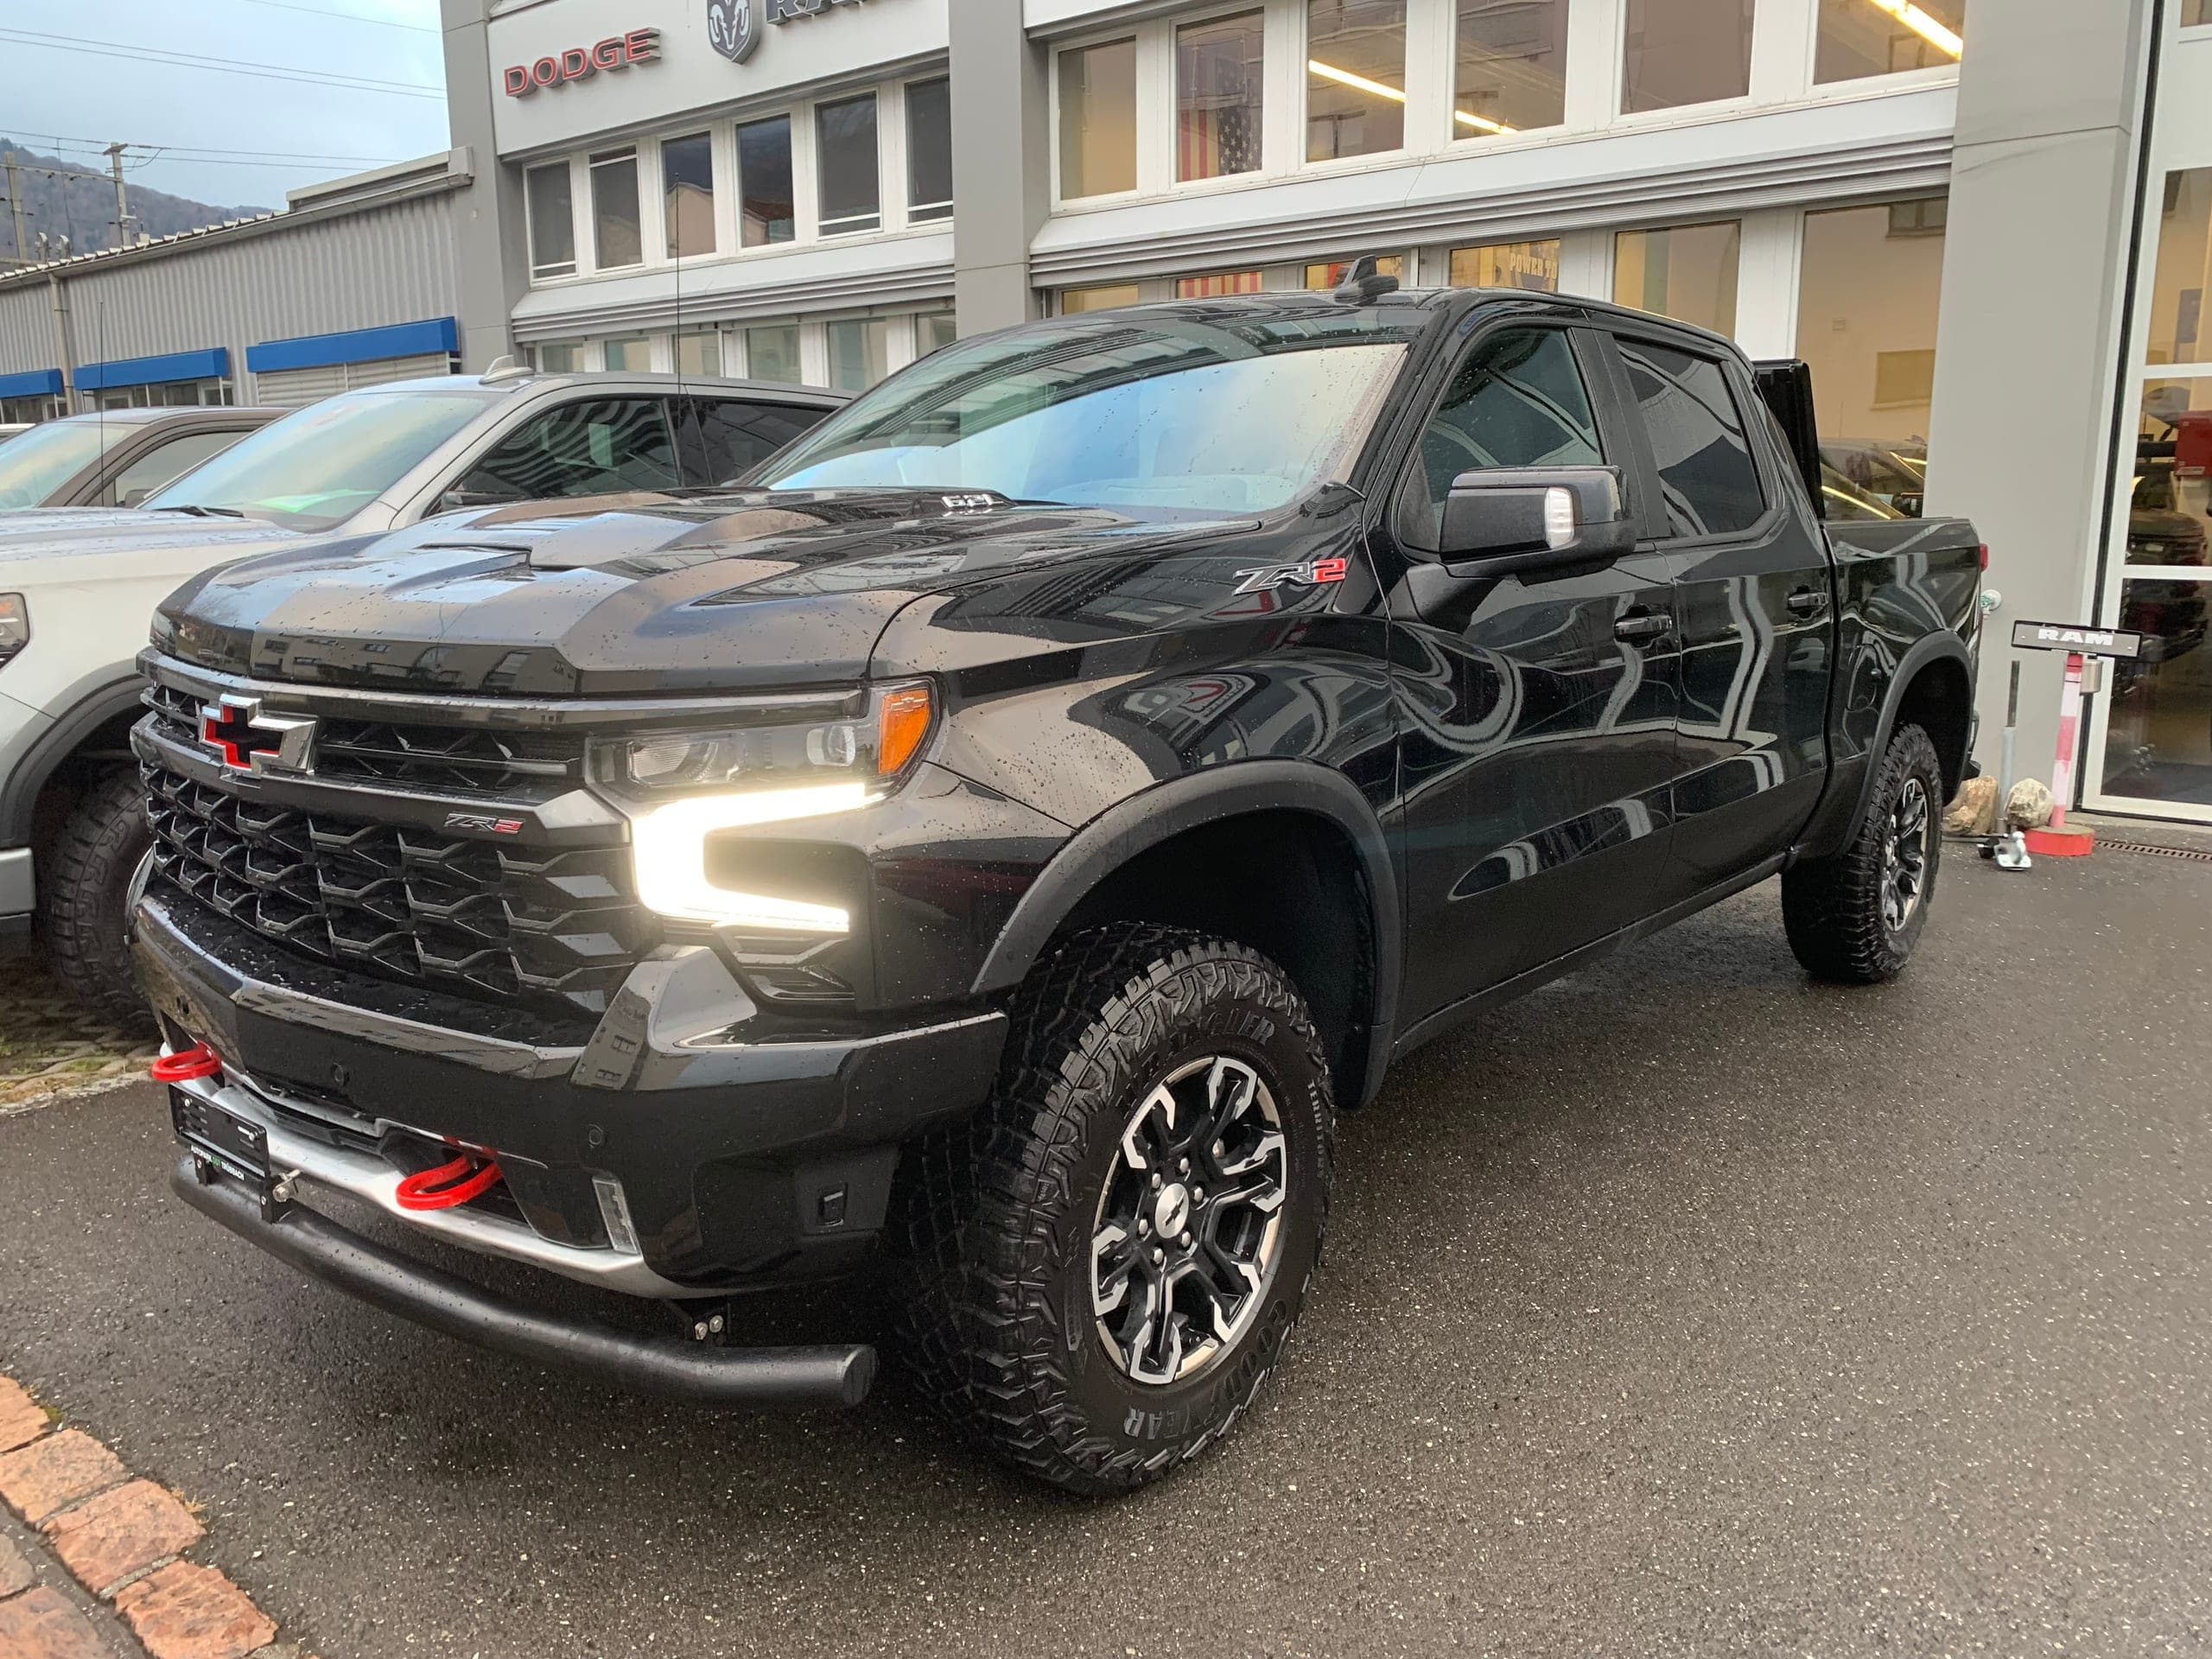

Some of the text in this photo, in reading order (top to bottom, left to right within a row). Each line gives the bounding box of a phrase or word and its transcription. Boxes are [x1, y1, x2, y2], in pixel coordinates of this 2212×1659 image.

[504, 27, 659, 98] DODGE
[1232, 557, 1346, 596] ZR2
[2037, 627, 2114, 646] RAM
[444, 812, 525, 835] ZR2
[1123, 1299, 1287, 1440] GOODYEAR
